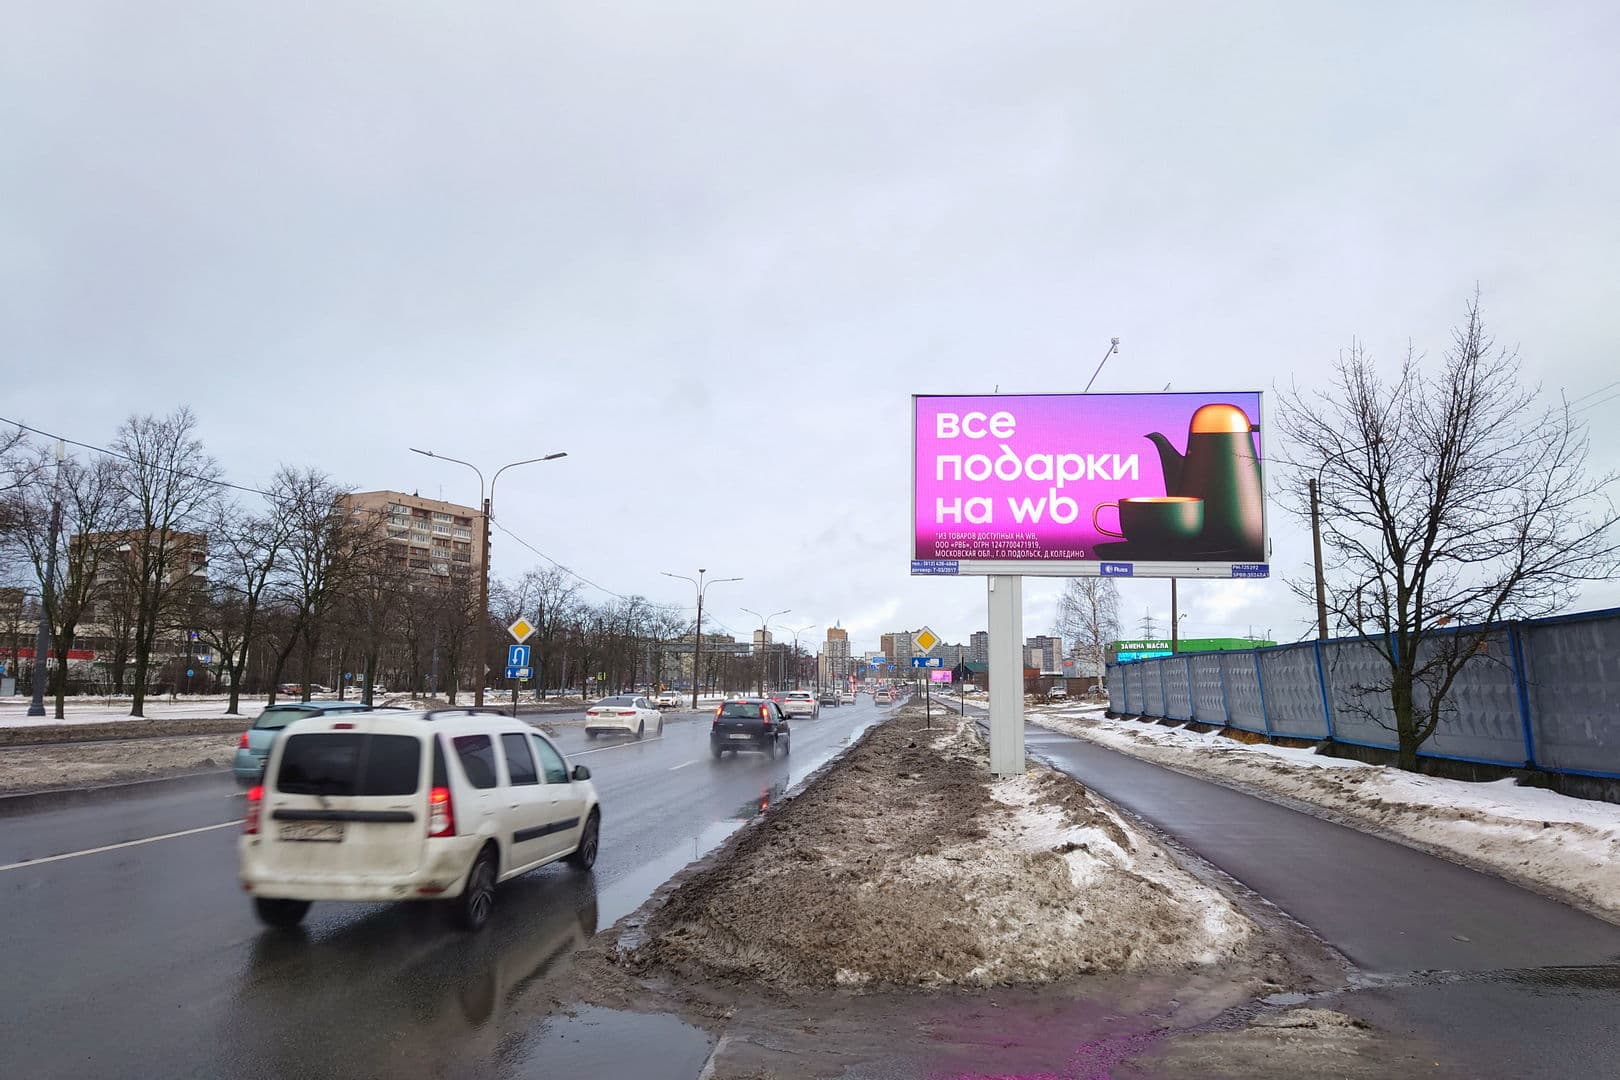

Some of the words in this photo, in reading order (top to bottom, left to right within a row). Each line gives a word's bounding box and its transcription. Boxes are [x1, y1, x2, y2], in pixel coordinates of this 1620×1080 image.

[936, 411, 1016, 439] все
[936, 444, 1139, 488] подарки
[936, 497, 993, 524] на
[1008, 488, 1079, 524] wb
[935, 541, 950, 549] ООО
[973, 541, 990, 549] ОГРН
[949, 532, 977, 540] ТОВАРОВ
[977, 532, 1014, 541] ДОСТУПНЫХ
[1015, 532, 1025, 540] НА
[935, 549, 977, 557] МОСКОВСКАЯ
